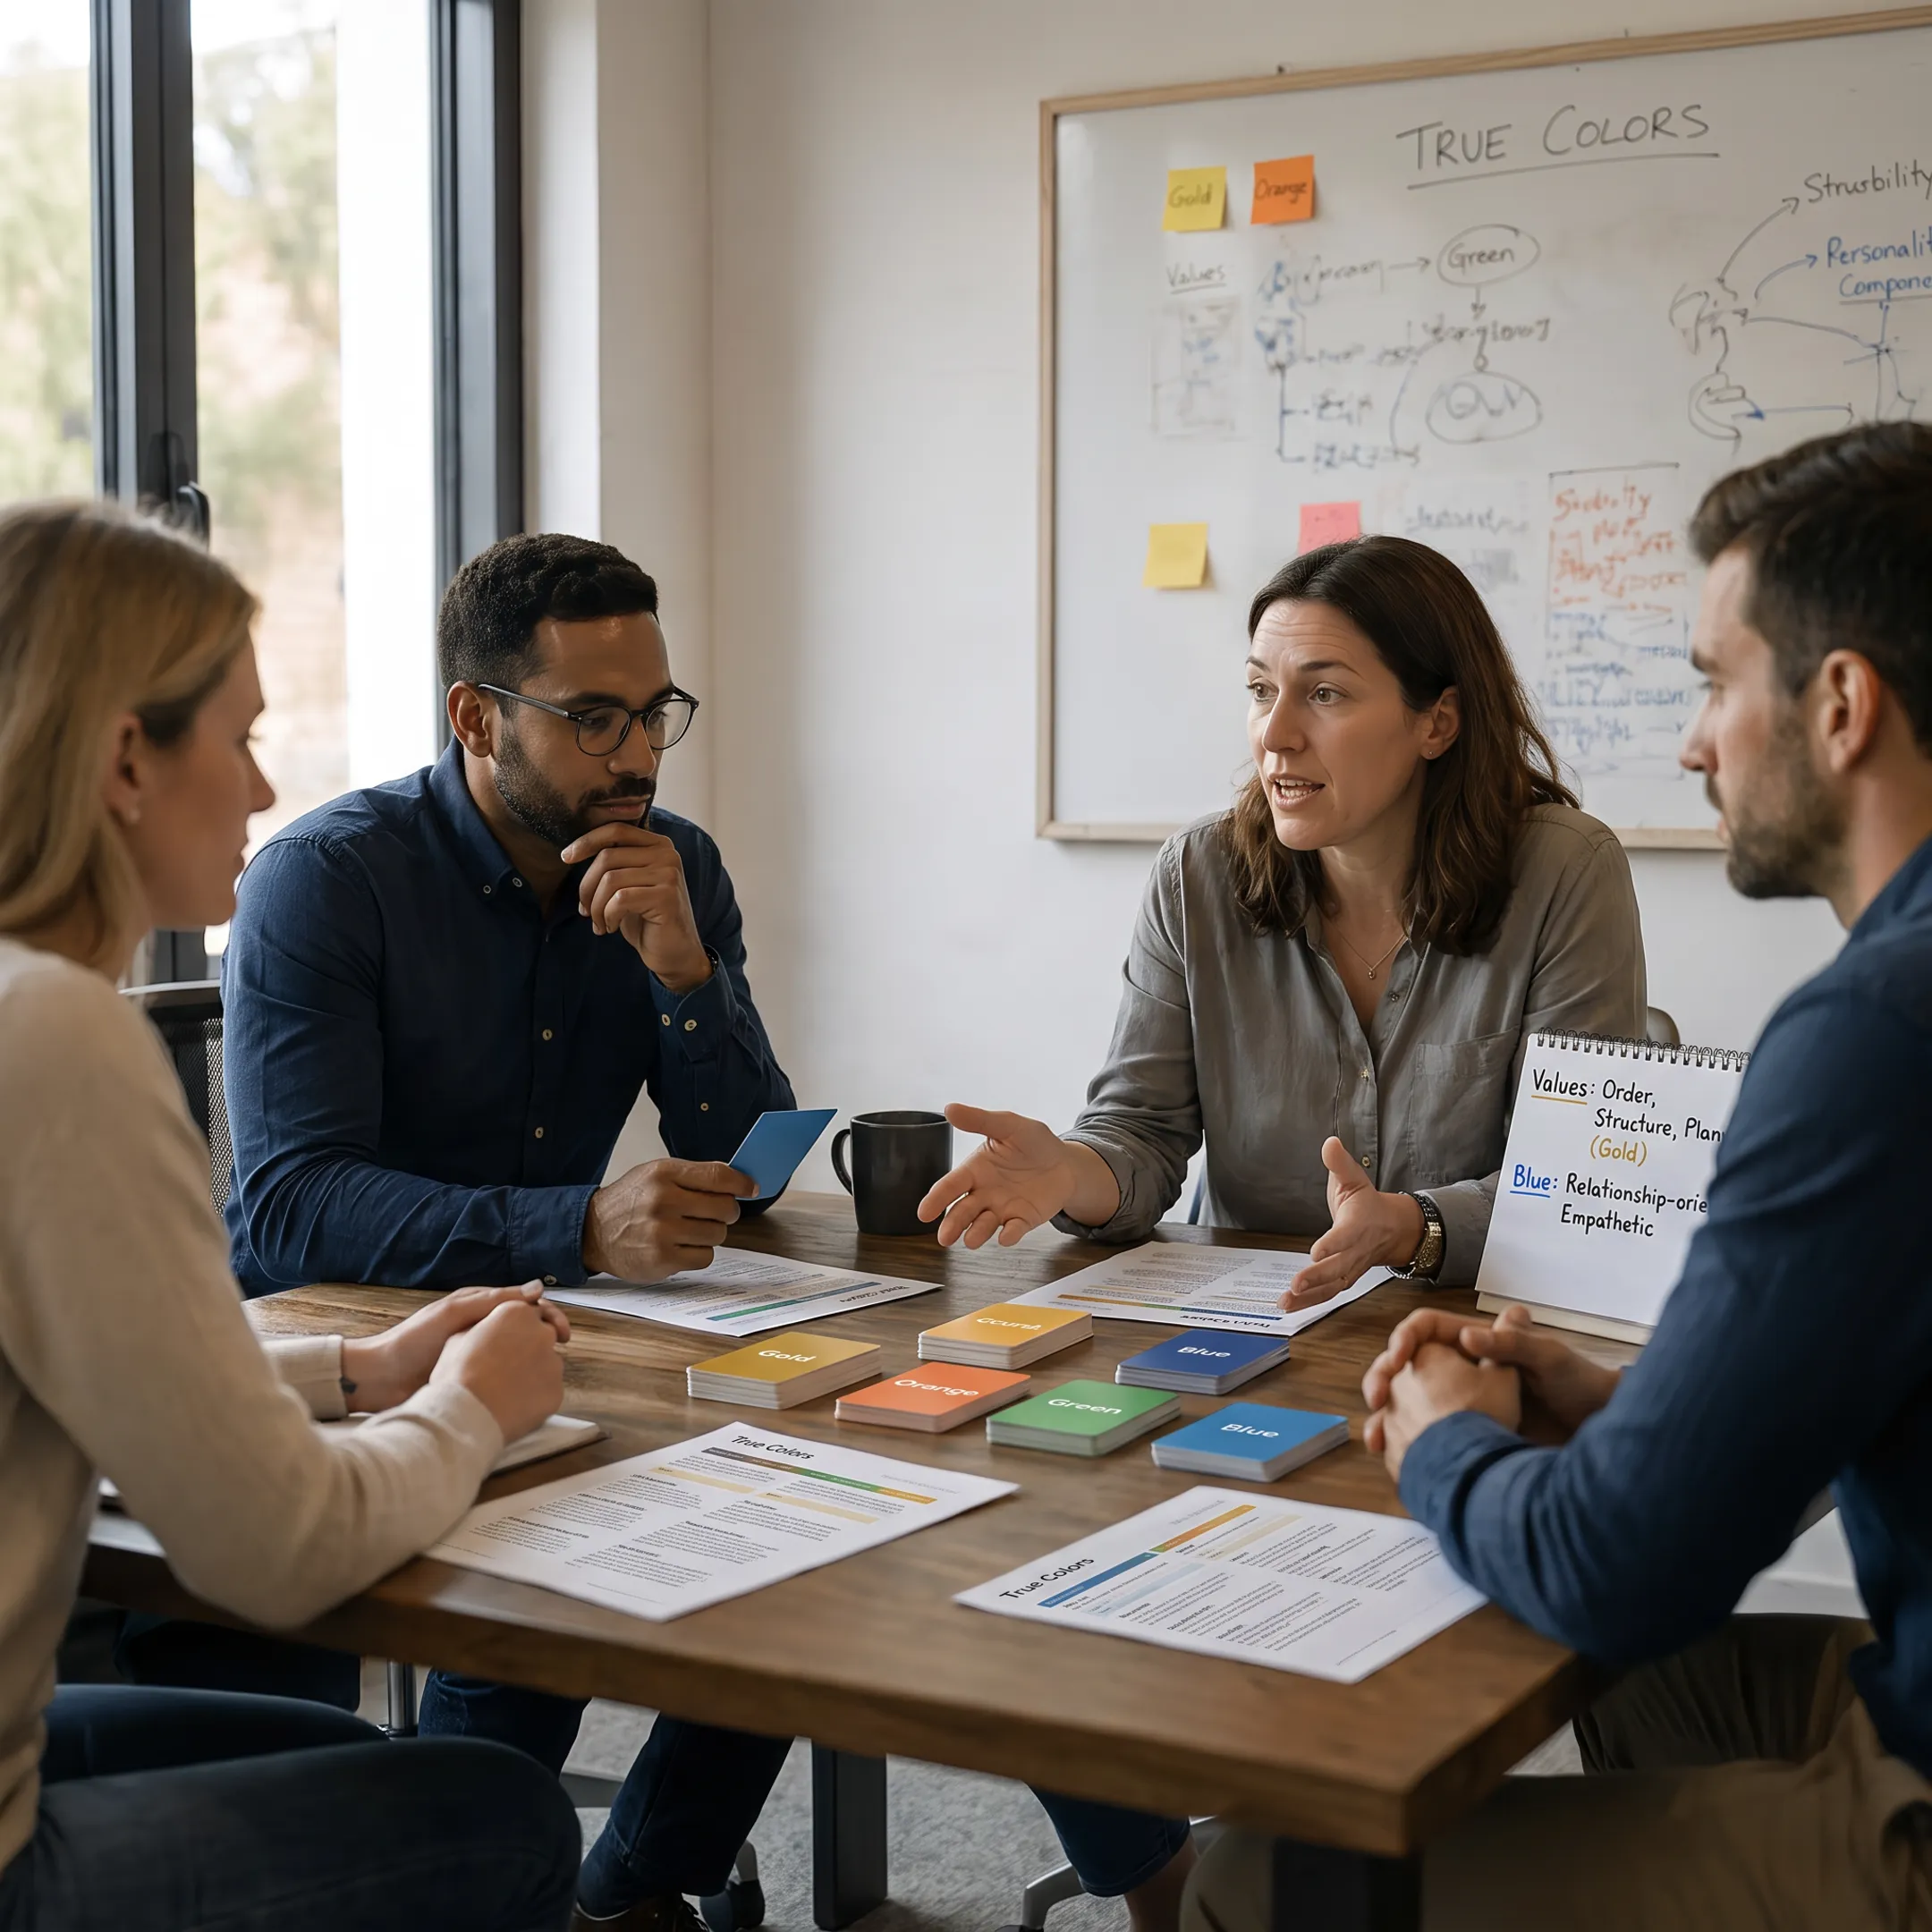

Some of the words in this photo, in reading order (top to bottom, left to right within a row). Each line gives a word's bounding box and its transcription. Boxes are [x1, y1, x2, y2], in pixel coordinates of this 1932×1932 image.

[1396, 121, 1513, 170] TRUE
[1543, 104, 1710, 156] COLORS
[1167, 182, 1214, 208] Gold
[1255, 178, 1308, 205] Orange
[1446, 244, 1517, 274] Green
[1166, 263, 1226, 287] Values
[1531, 1069, 1596, 1097] Values:
[1601, 1079, 1657, 1109] Order,
[1593, 1108, 1677, 1142] Structure,
[1684, 1116, 1725, 1142] Plan
[1589, 1134, 1648, 1166] (Gold)
[1513, 1164, 1559, 1191] Blue:
[1560, 1203, 1655, 1237] Empathetic
[758, 1349, 816, 1363] Gold
[1176, 1345, 1232, 1359] Blue
[894, 1378, 979, 1397] Orange
[1047, 1398, 1123, 1416] Green
[1220, 1422, 1279, 1439] Blue
[731, 1435, 766, 1450] True
[766, 1442, 816, 1461] Colors
[998, 1580, 1046, 1600] True
[1039, 1556, 1096, 1583] Colors
